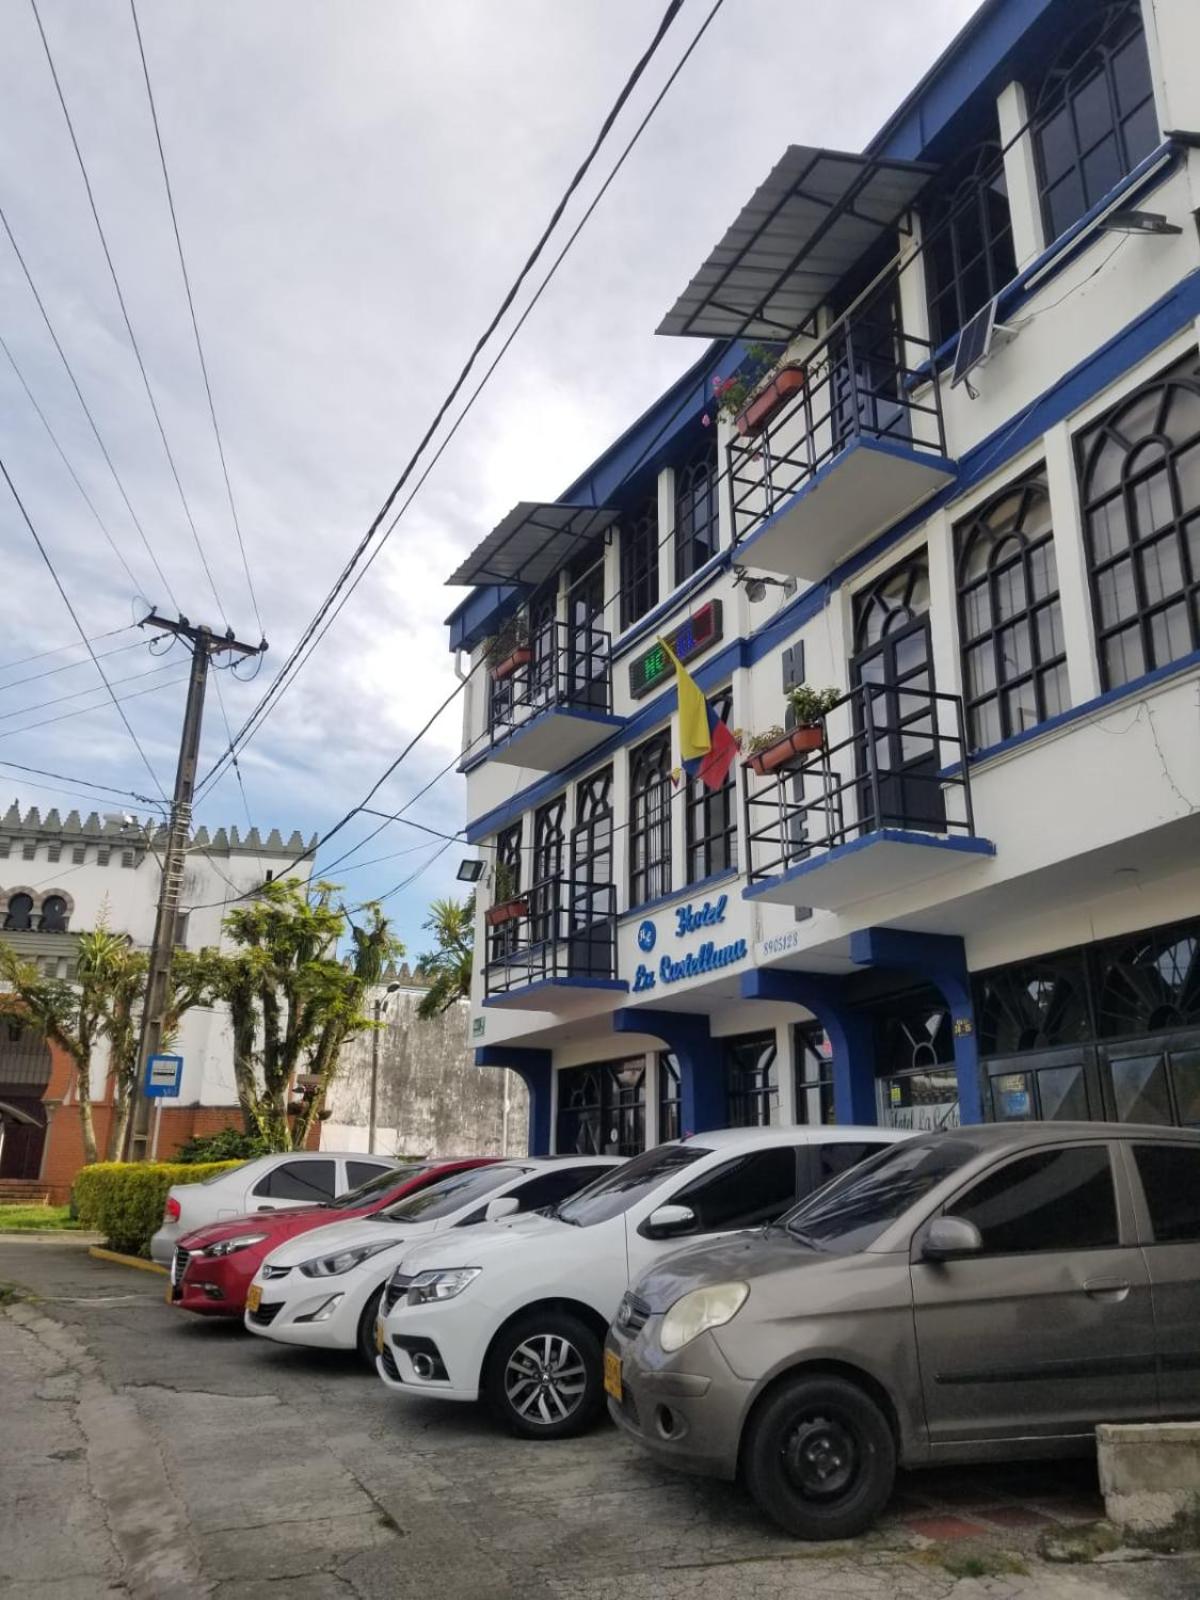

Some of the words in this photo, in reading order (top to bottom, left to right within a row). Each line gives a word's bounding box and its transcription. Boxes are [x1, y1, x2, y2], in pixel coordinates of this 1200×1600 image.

[675, 894, 728, 938] Hotel
[632, 964, 656, 992] La
[659, 939, 748, 984] Castellana
[763, 931, 799, 956] 8905128
